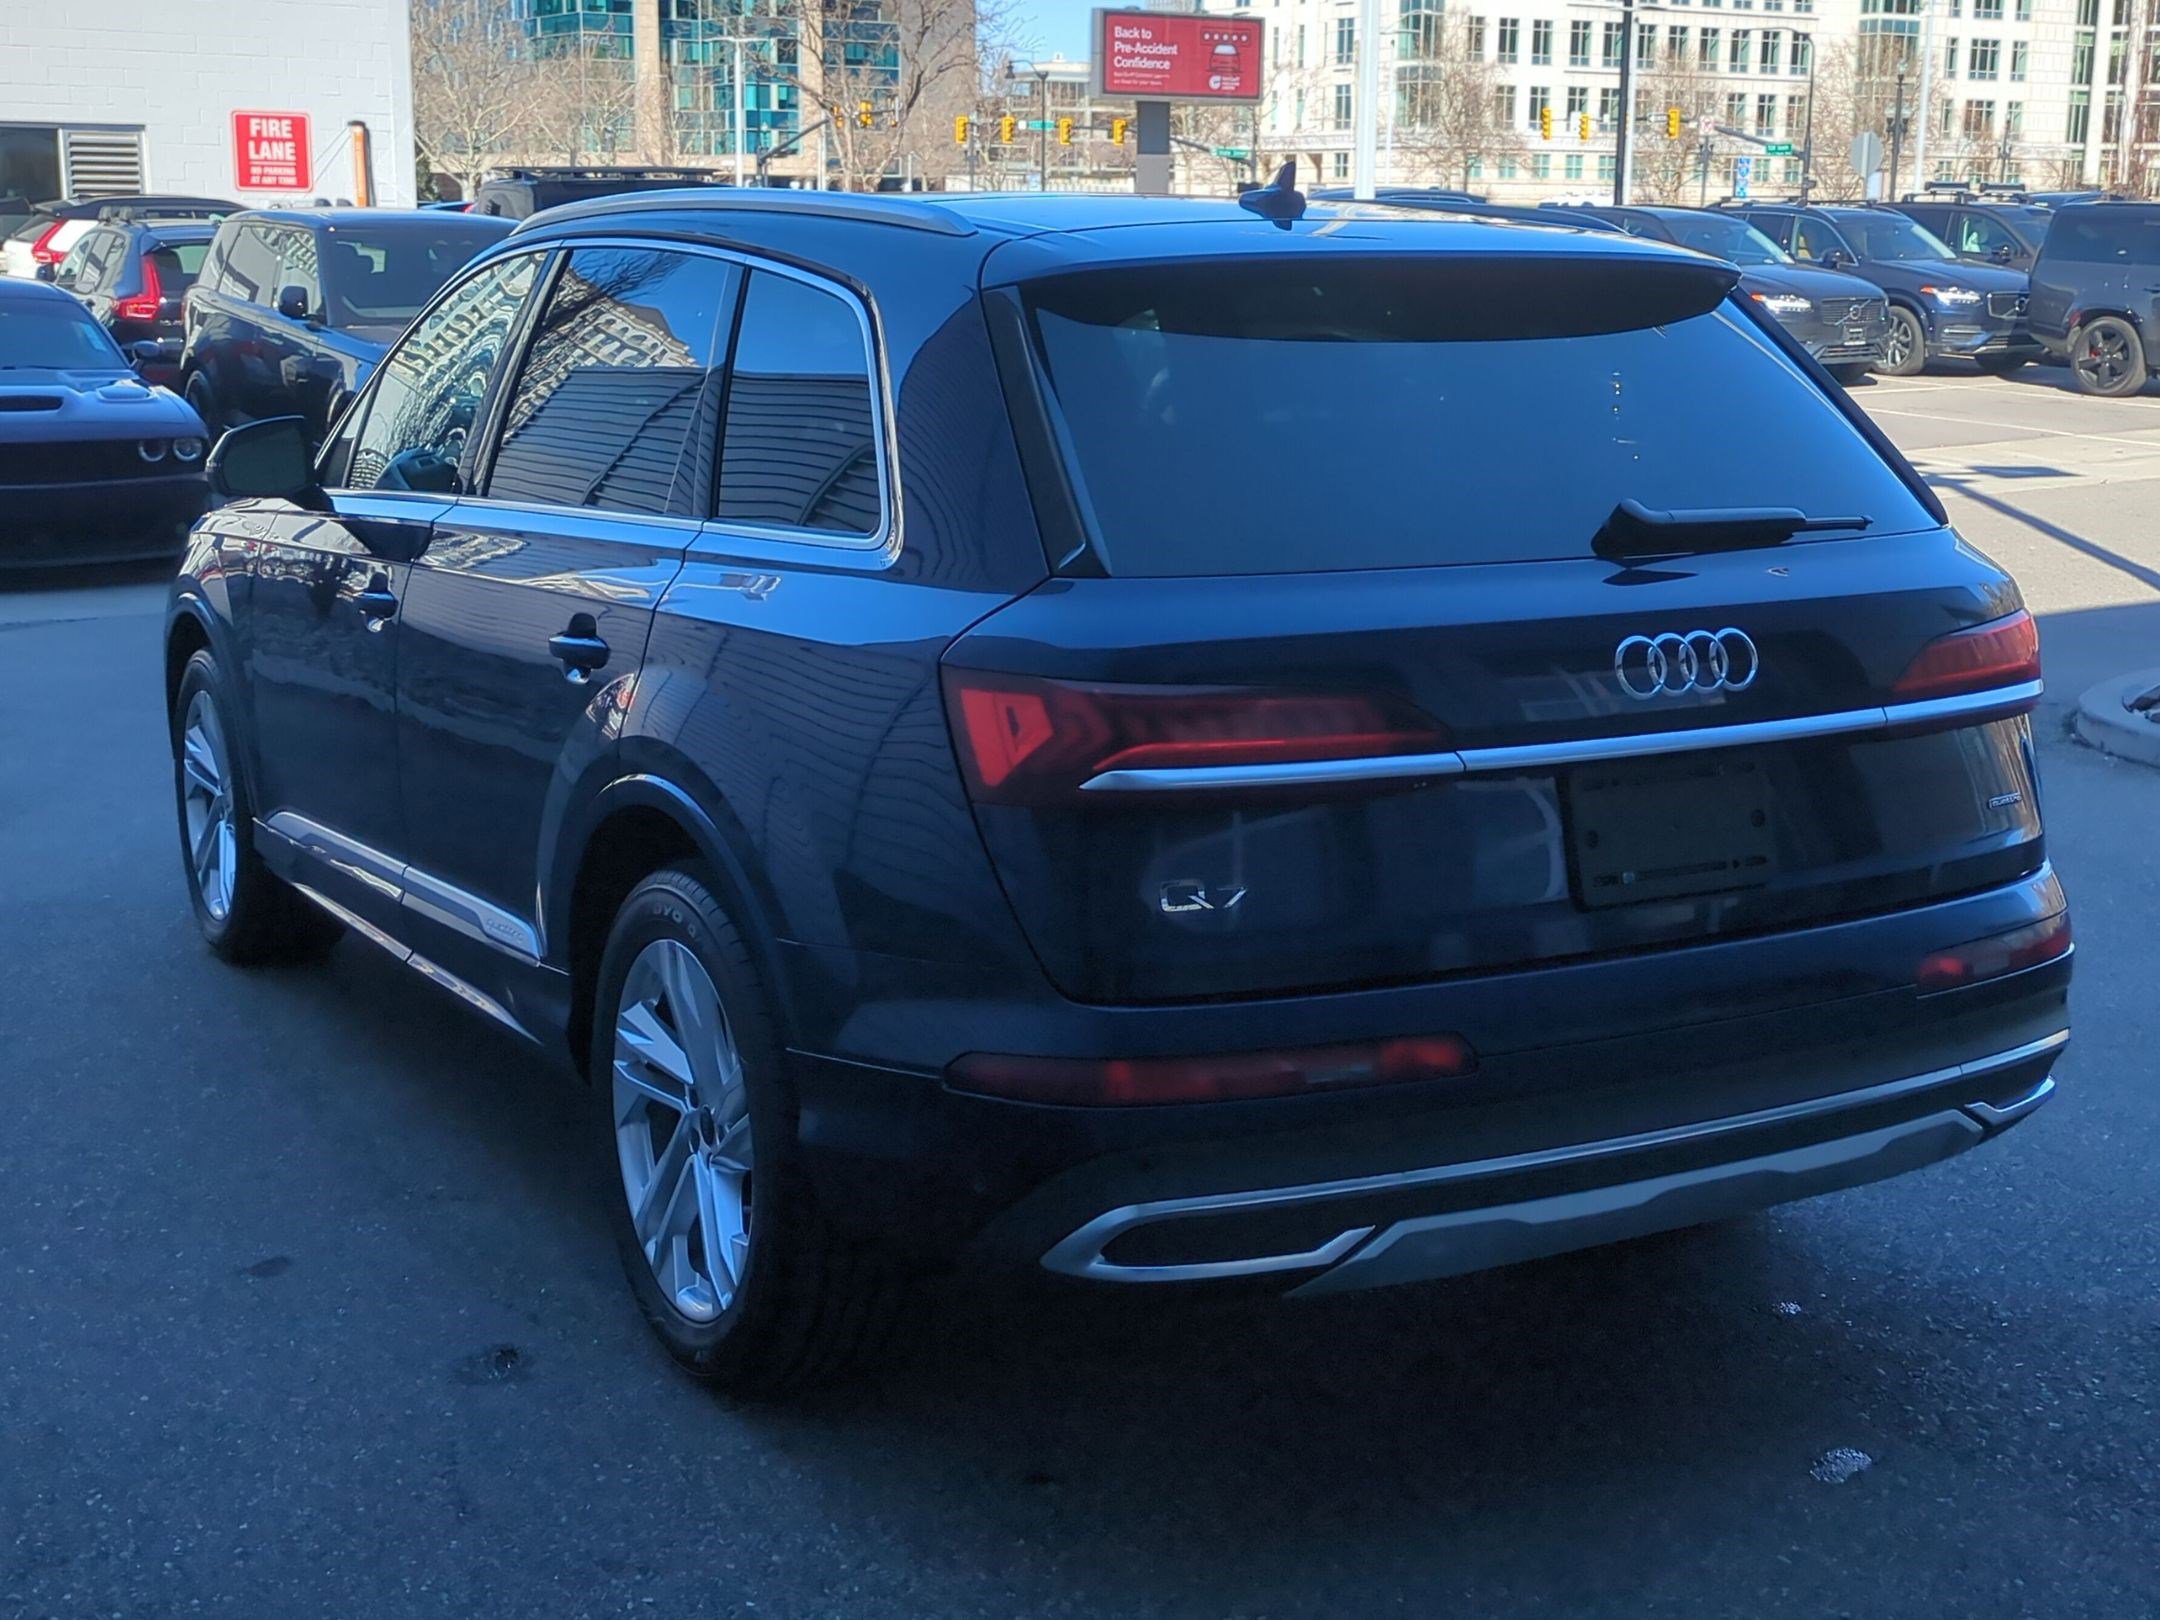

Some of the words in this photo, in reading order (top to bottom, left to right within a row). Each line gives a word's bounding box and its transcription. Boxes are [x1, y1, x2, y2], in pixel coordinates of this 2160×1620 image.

[1114, 26, 1140, 38] Back
[1141, 28, 1152, 39] to
[1114, 41, 1178, 55] Pre-Accident
[1114, 56, 1171, 69] Confidence
[249, 117, 293, 138] FIRE
[248, 140, 296, 160] LANE
[250, 166, 262, 175] NO
[263, 166, 296, 176] PARKING
[250, 176, 260, 184] AT
[261, 176, 277, 185] ANY
[1160, 879, 1247, 912] Q7
